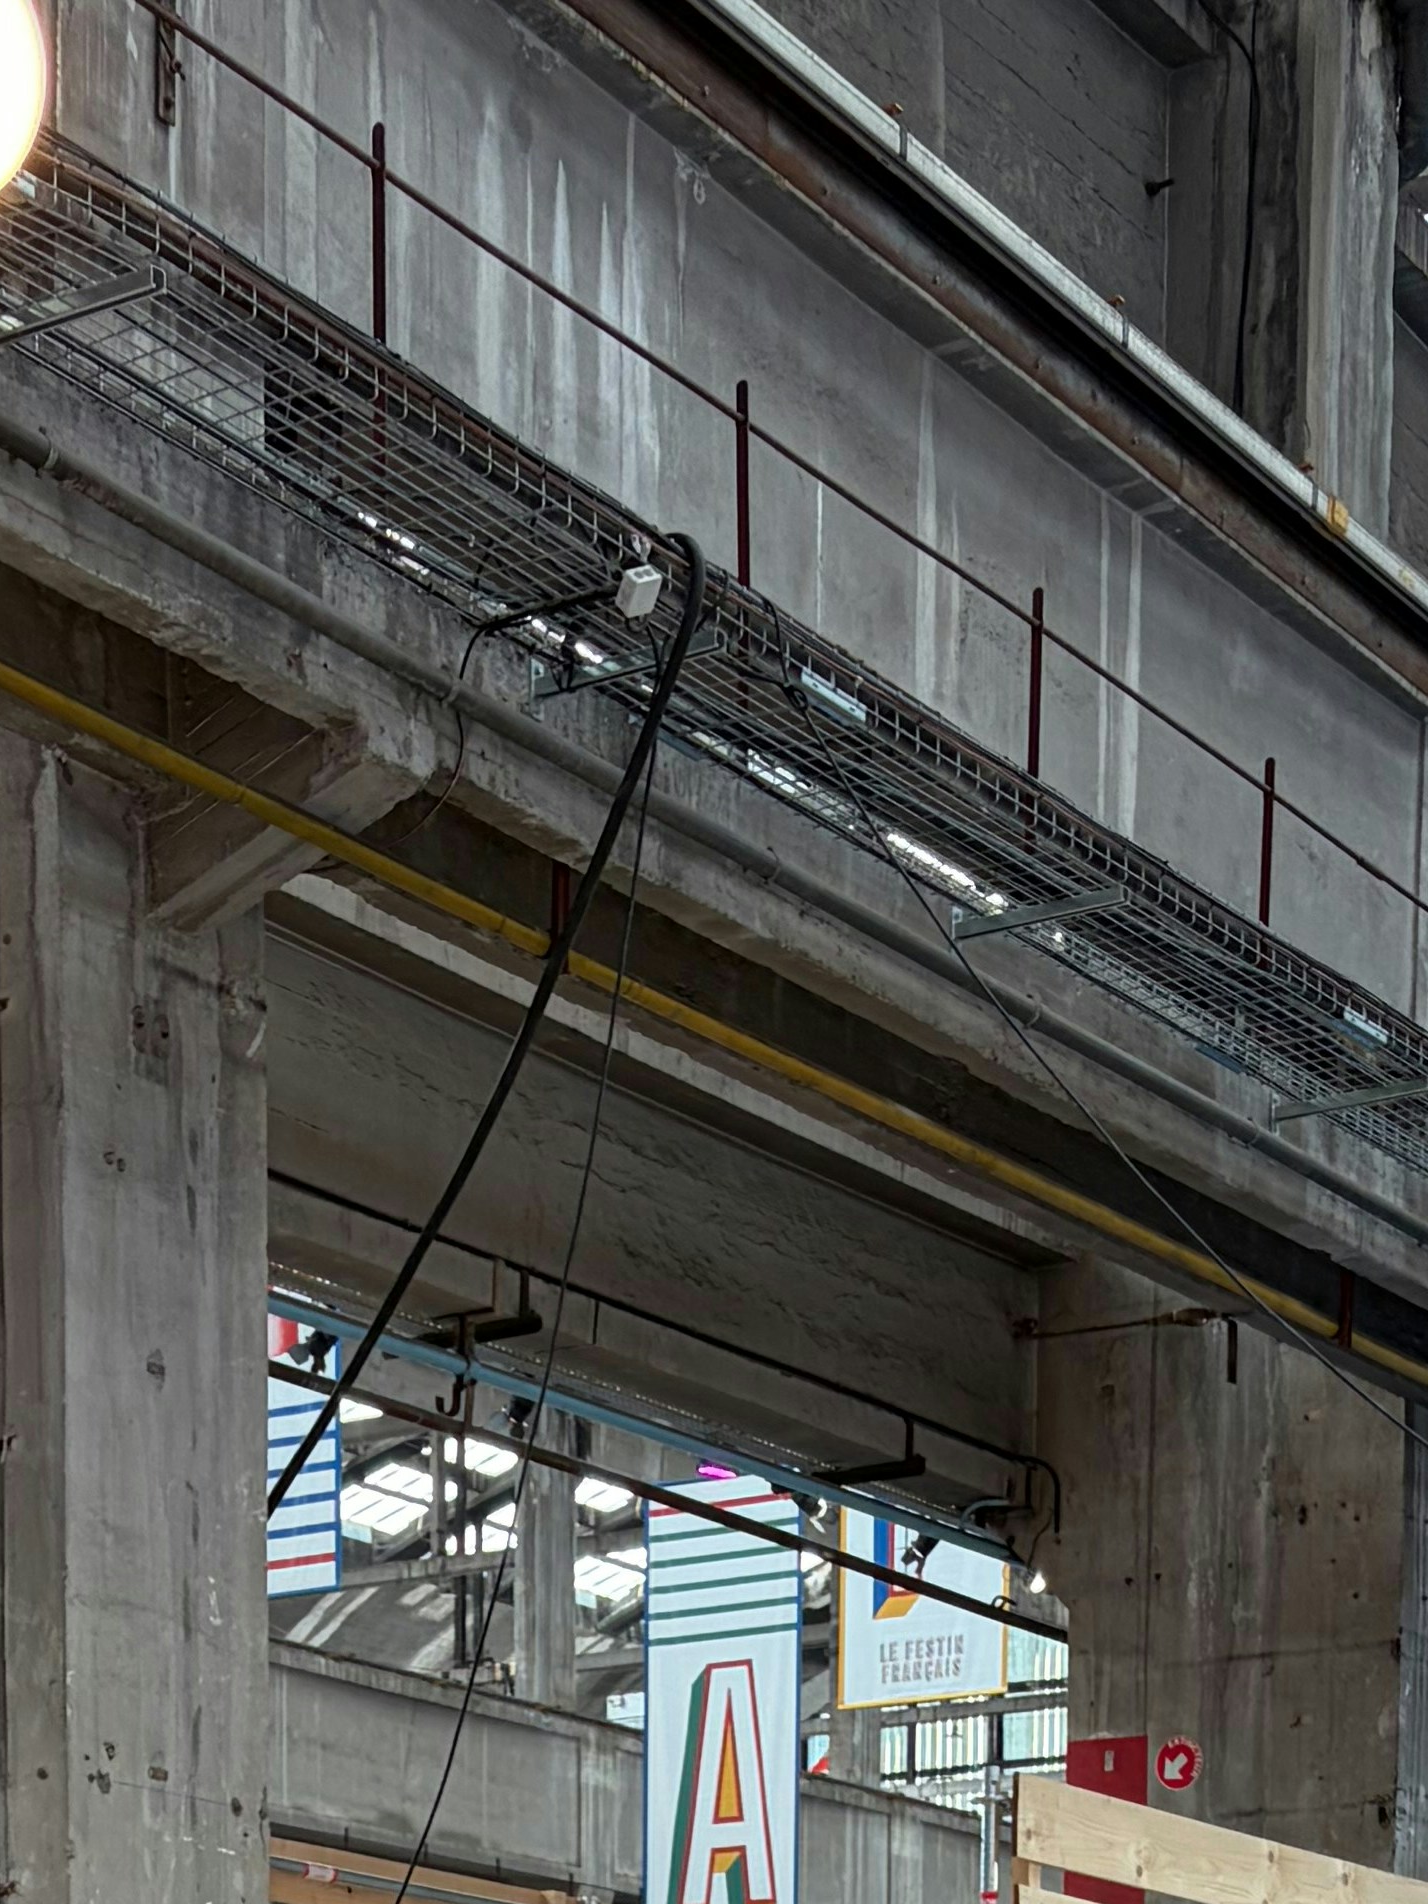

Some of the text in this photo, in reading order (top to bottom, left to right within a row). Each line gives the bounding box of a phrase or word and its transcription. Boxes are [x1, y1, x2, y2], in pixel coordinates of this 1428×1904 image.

[880, 1634, 964, 1663] LE FESTIN
[881, 1657, 961, 1684] FRANÇAIS
